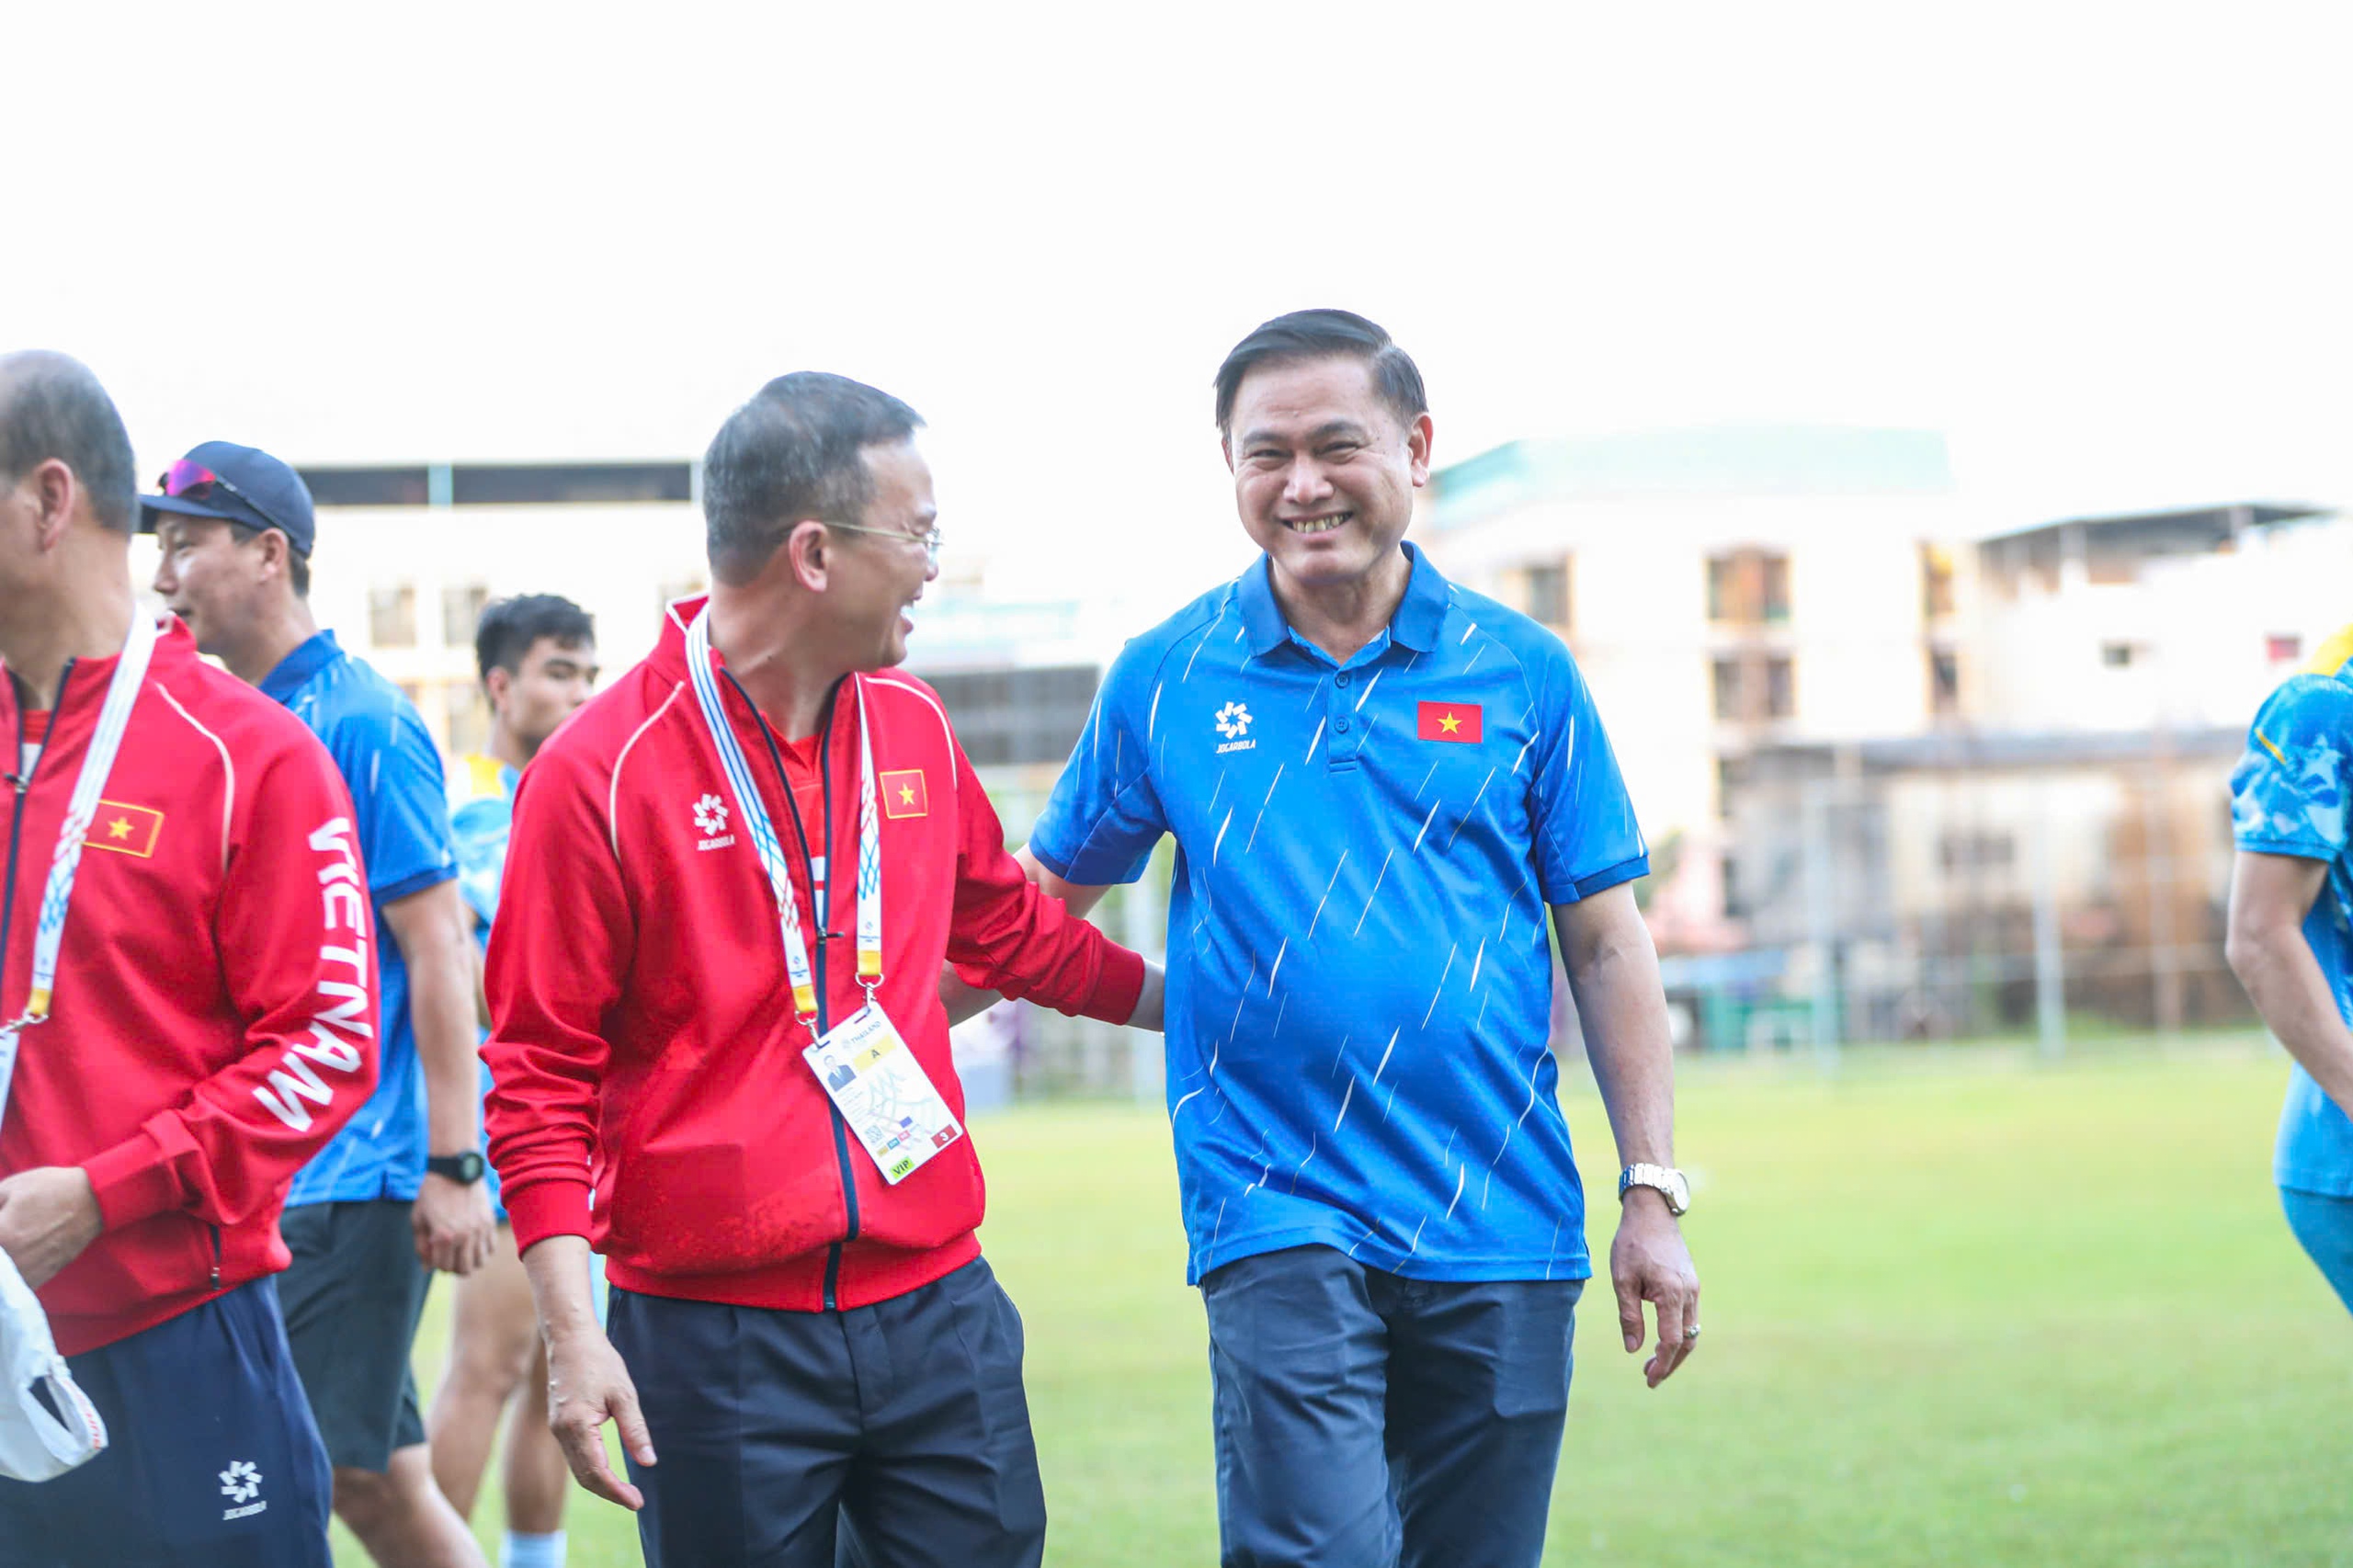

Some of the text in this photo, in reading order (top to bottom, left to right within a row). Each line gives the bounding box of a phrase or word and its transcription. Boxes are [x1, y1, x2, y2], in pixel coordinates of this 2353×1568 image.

[253, 817, 374, 1132] VIETNAM
[870, 1049, 881, 1059] A
[892, 1160, 910, 1175] VIP
